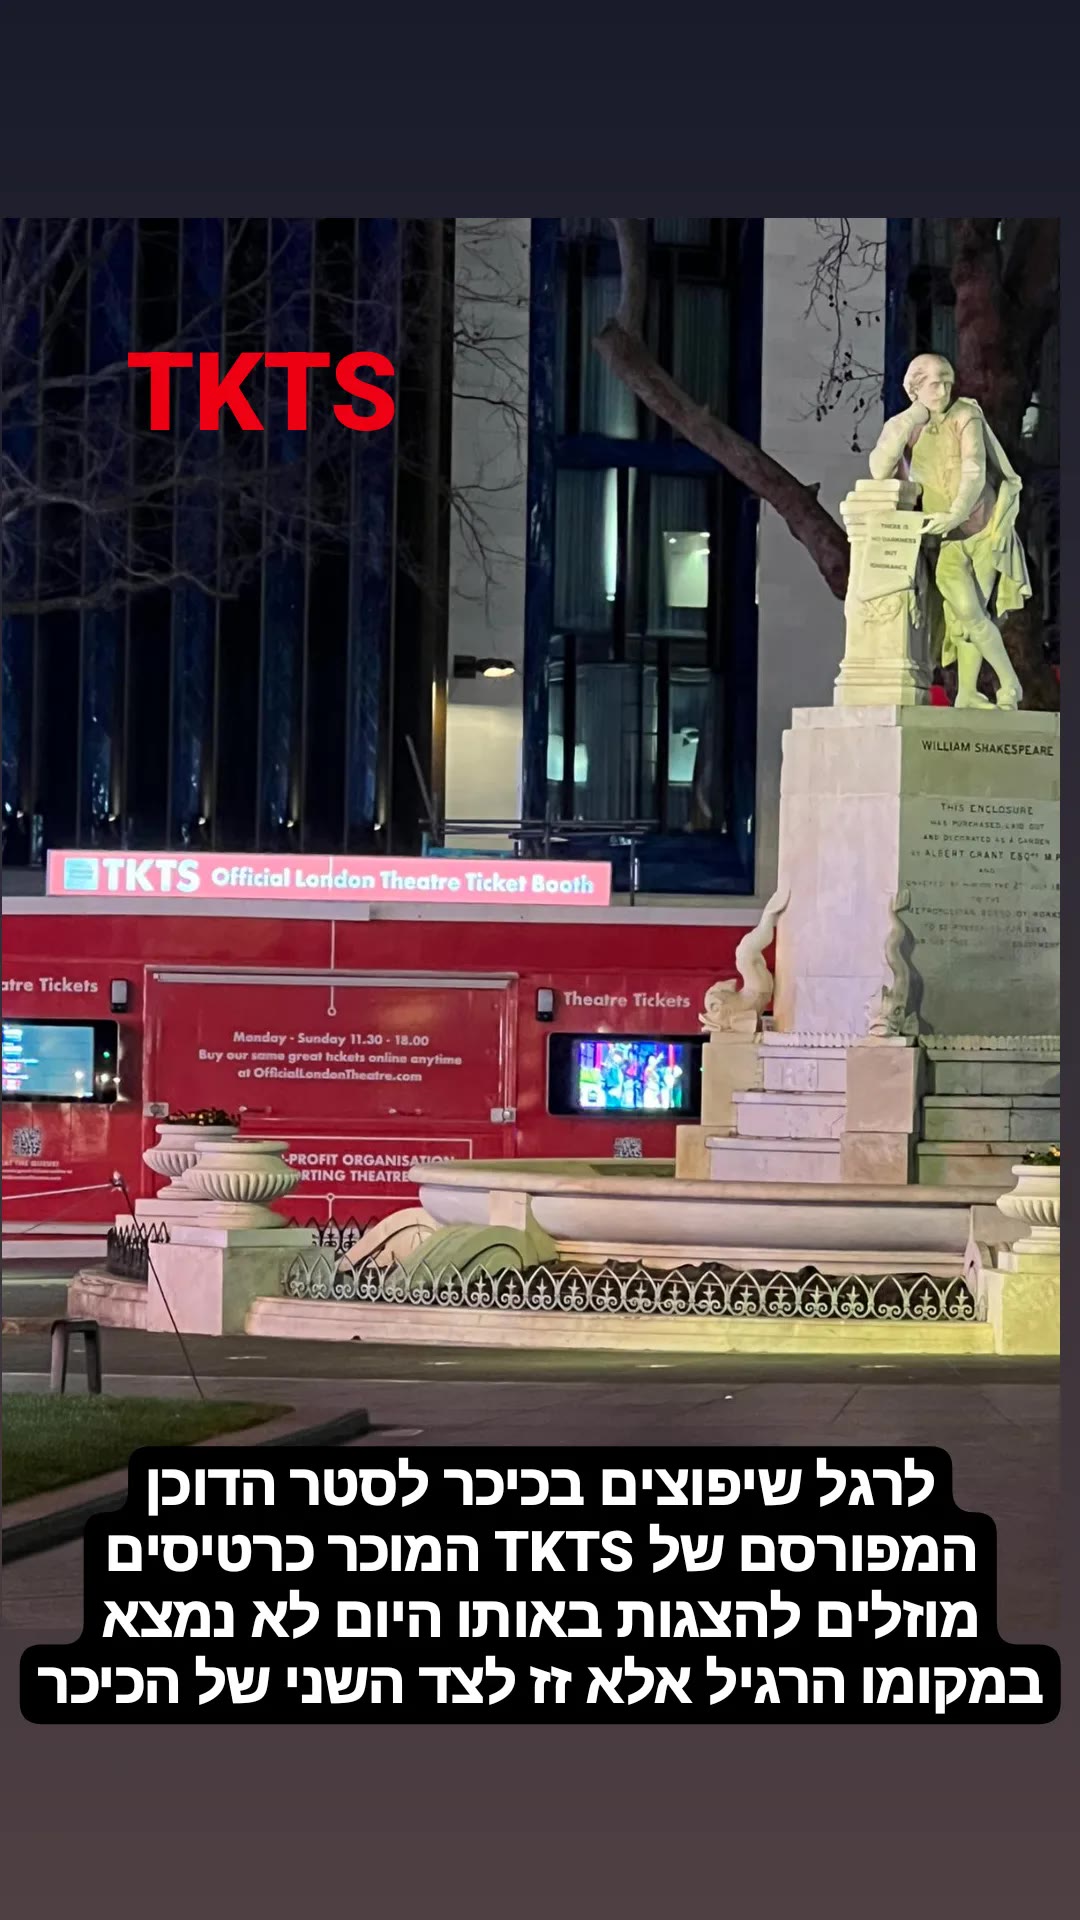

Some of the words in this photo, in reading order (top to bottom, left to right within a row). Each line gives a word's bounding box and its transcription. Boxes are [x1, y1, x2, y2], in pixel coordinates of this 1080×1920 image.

[922, 740, 971, 752] WILLIAM
[975, 743, 1054, 757] SHAKESPEARE
[941, 803, 965, 812] THIS
[970, 804, 1034, 816] ENCLOSURE
[943, 834, 991, 844] DECORATED
[1009, 836, 1014, 844] A
[1018, 837, 1051, 846] GARDEN
[925, 850, 964, 859] ALBERT
[969, 851, 1004, 860] GRANT
[103, 858, 200, 893] TKTS
[211, 866, 291, 888] Official
[295, 868, 376, 889] London
[379, 870, 461, 892] Theatre
[465, 872, 528, 893] Ticket
[531, 873, 594, 894] Booth
[2, 979, 34, 992] atre
[39, 976, 98, 992] Tickets
[563, 990, 627, 1007] Theatre
[633, 991, 690, 1008] Tickets
[233, 1031, 287, 1046] Monday
[297, 1032, 346, 1047] Sunday
[350, 1033, 383, 1045] 11.30
[395, 1034, 429, 1046] 18.00
[199, 1049, 223, 1063] Buy
[226, 1052, 248, 1060] our
[251, 1052, 285, 1061] same
[288, 1052, 322, 1064] great
[326, 1051, 365, 1063] tickets
[368, 1052, 407, 1063] online
[410, 1054, 462, 1067] anytime
[237, 1068, 251, 1078] at
[253, 1067, 422, 1081] OfficialLondonTheatre.com
[300, 1169, 346, 1182] RTING
[350, 1170, 409, 1183] THEATRE
